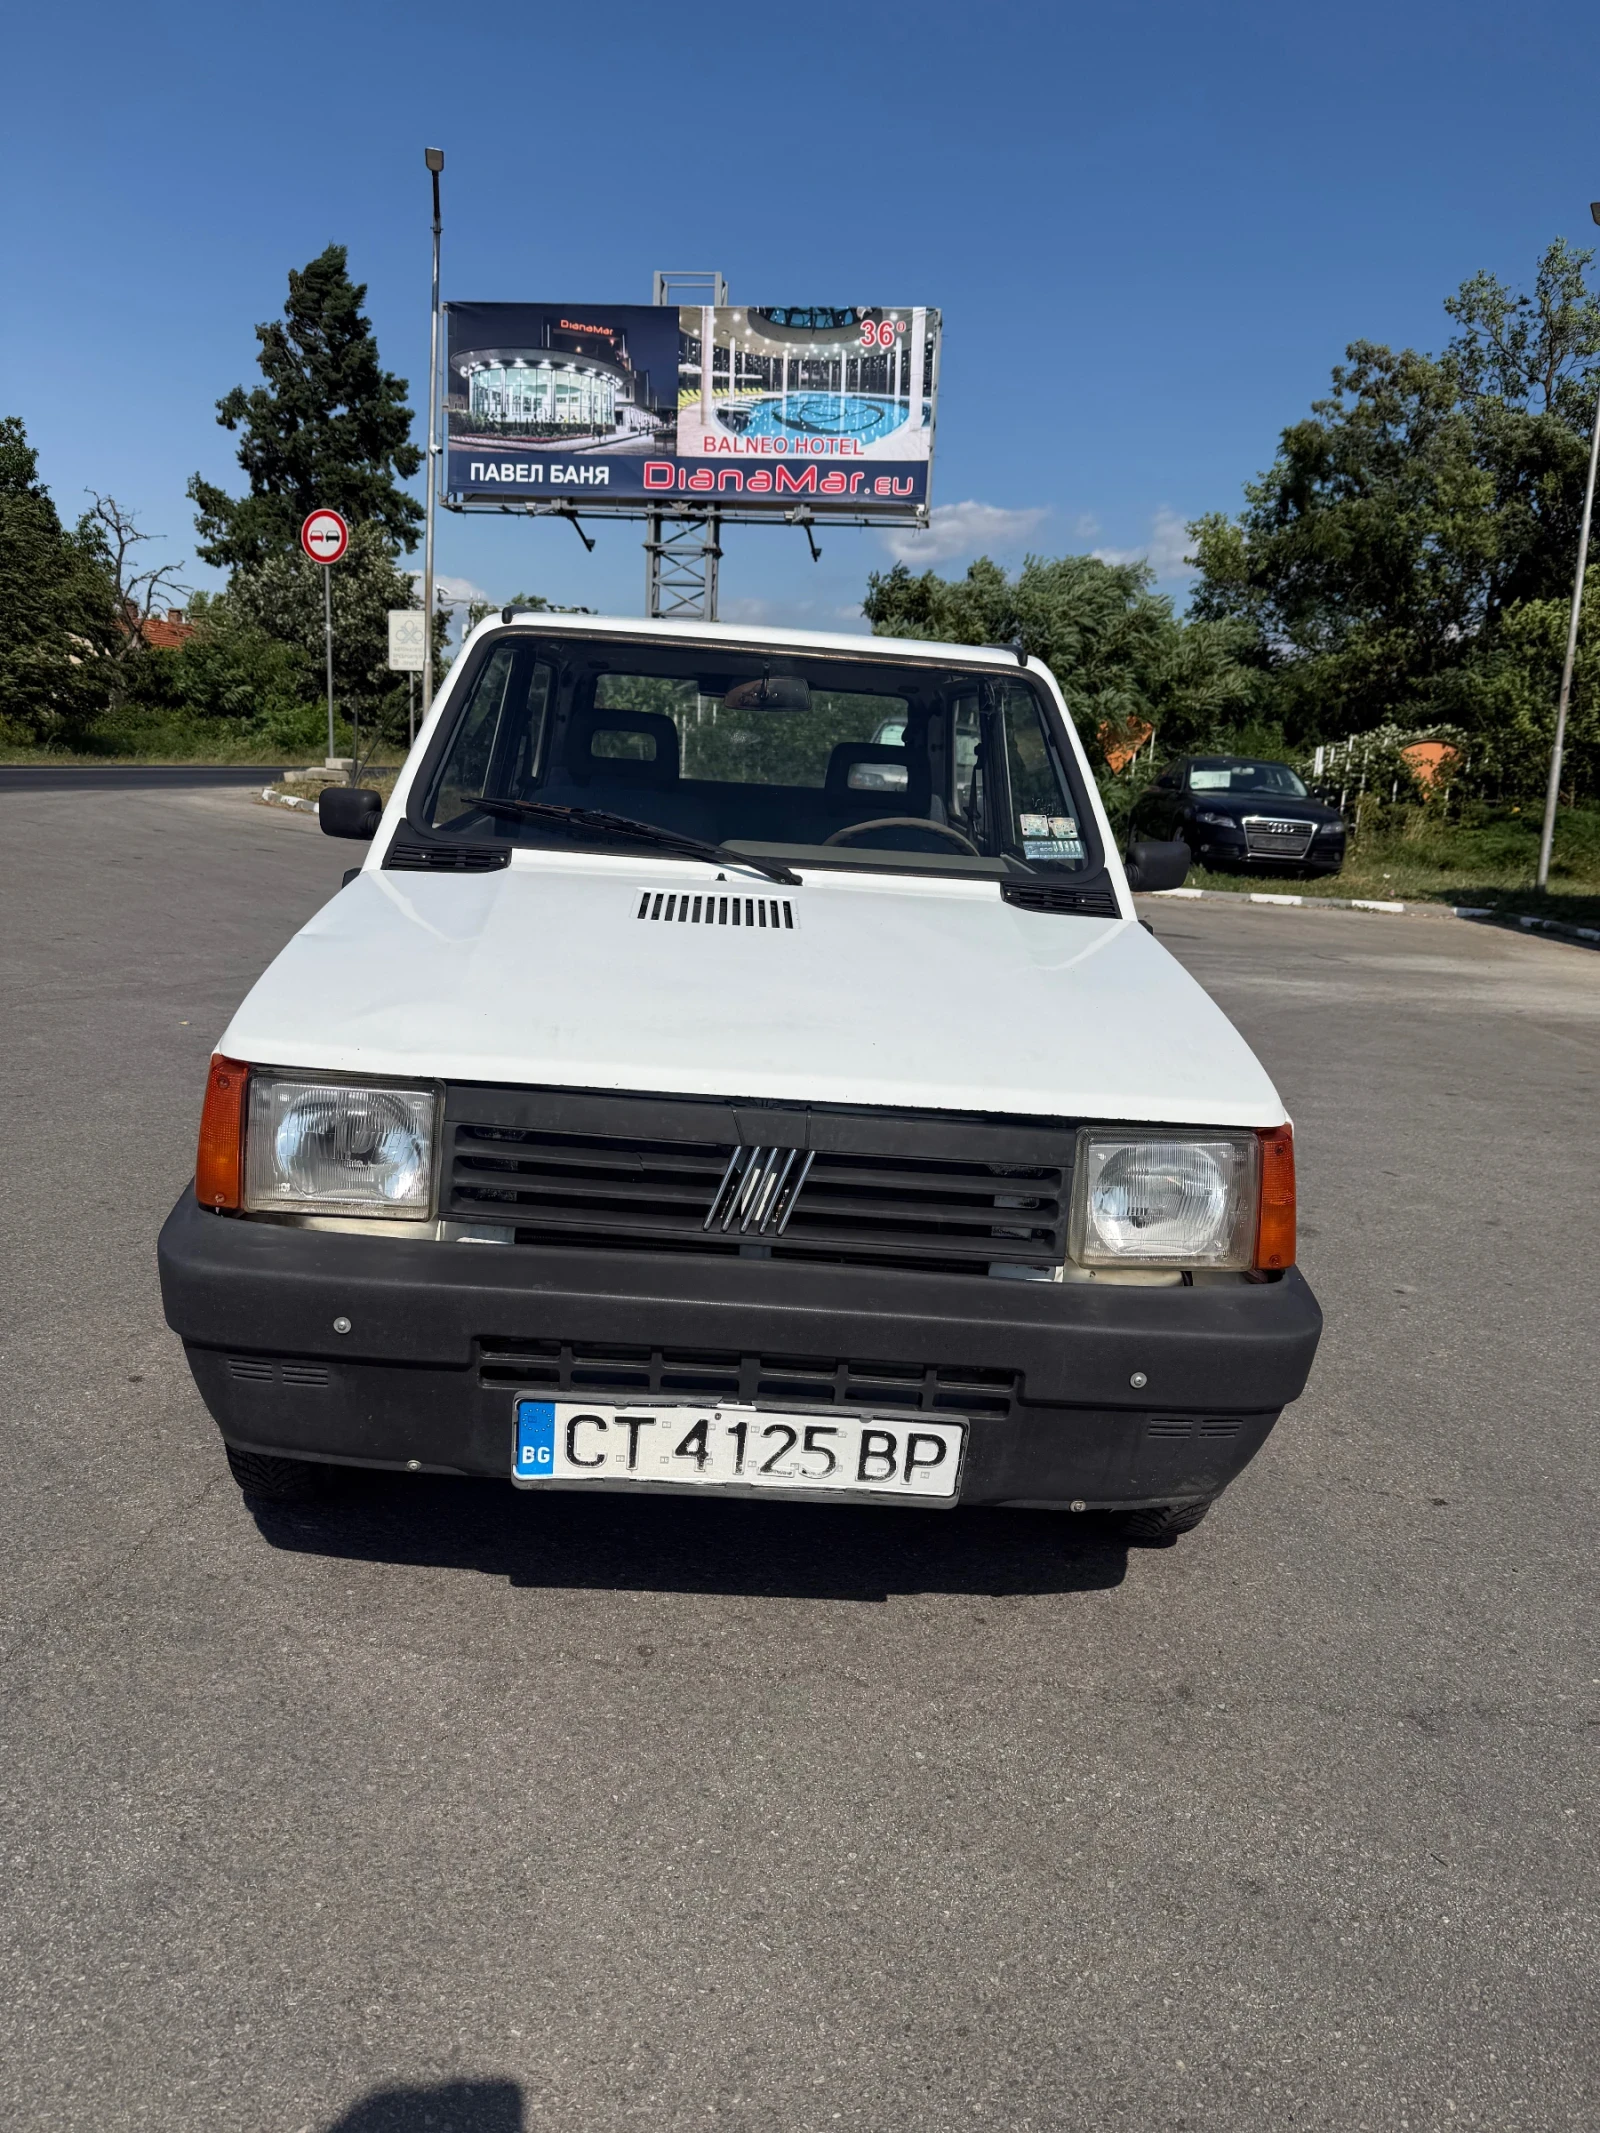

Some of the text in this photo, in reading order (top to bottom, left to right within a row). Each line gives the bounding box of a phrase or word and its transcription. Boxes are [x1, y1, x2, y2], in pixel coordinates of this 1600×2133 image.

[703, 435, 865, 455] BALNEO HOTEL
[470, 462, 610, 485] ПАВЕЛ БАНЯ
[522, 1446, 552, 1464] BG
[565, 1413, 949, 1485] CT 4125 BP
